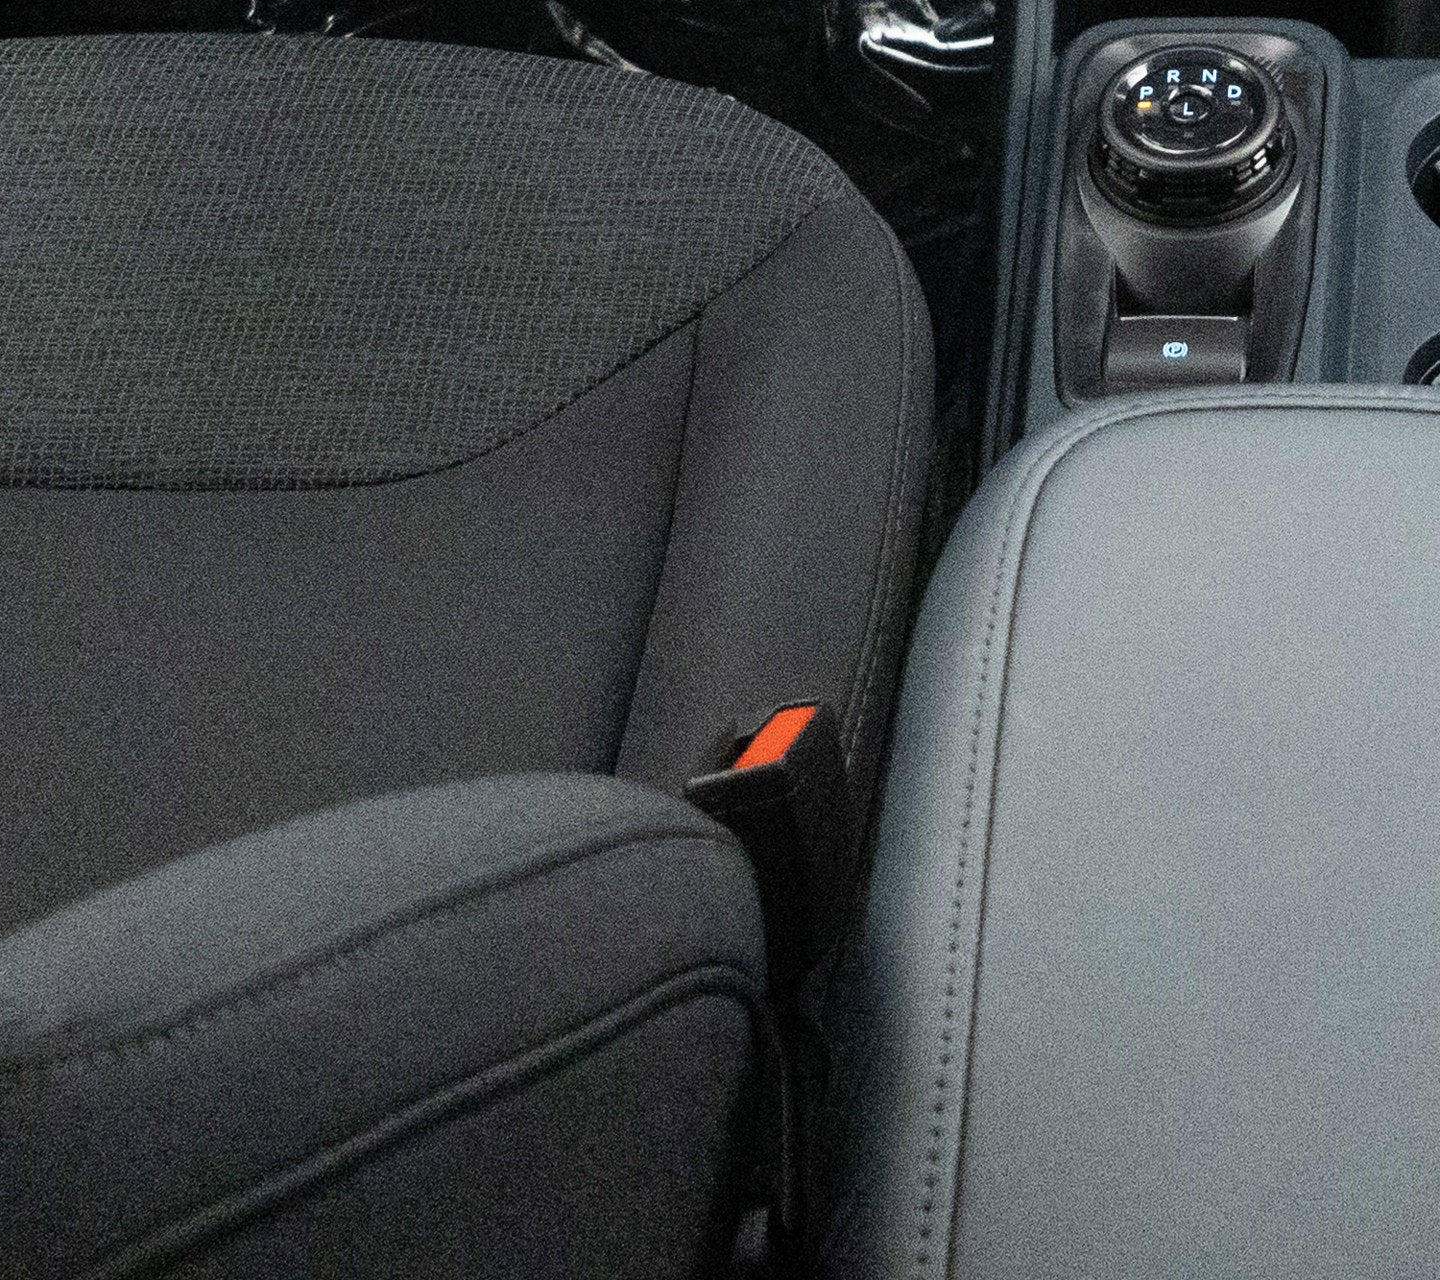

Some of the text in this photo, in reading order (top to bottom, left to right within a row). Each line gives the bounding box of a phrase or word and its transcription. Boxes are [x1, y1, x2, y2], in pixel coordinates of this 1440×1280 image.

[1140, 69, 1242, 101] P R N D
[1183, 101, 1194, 116] L
